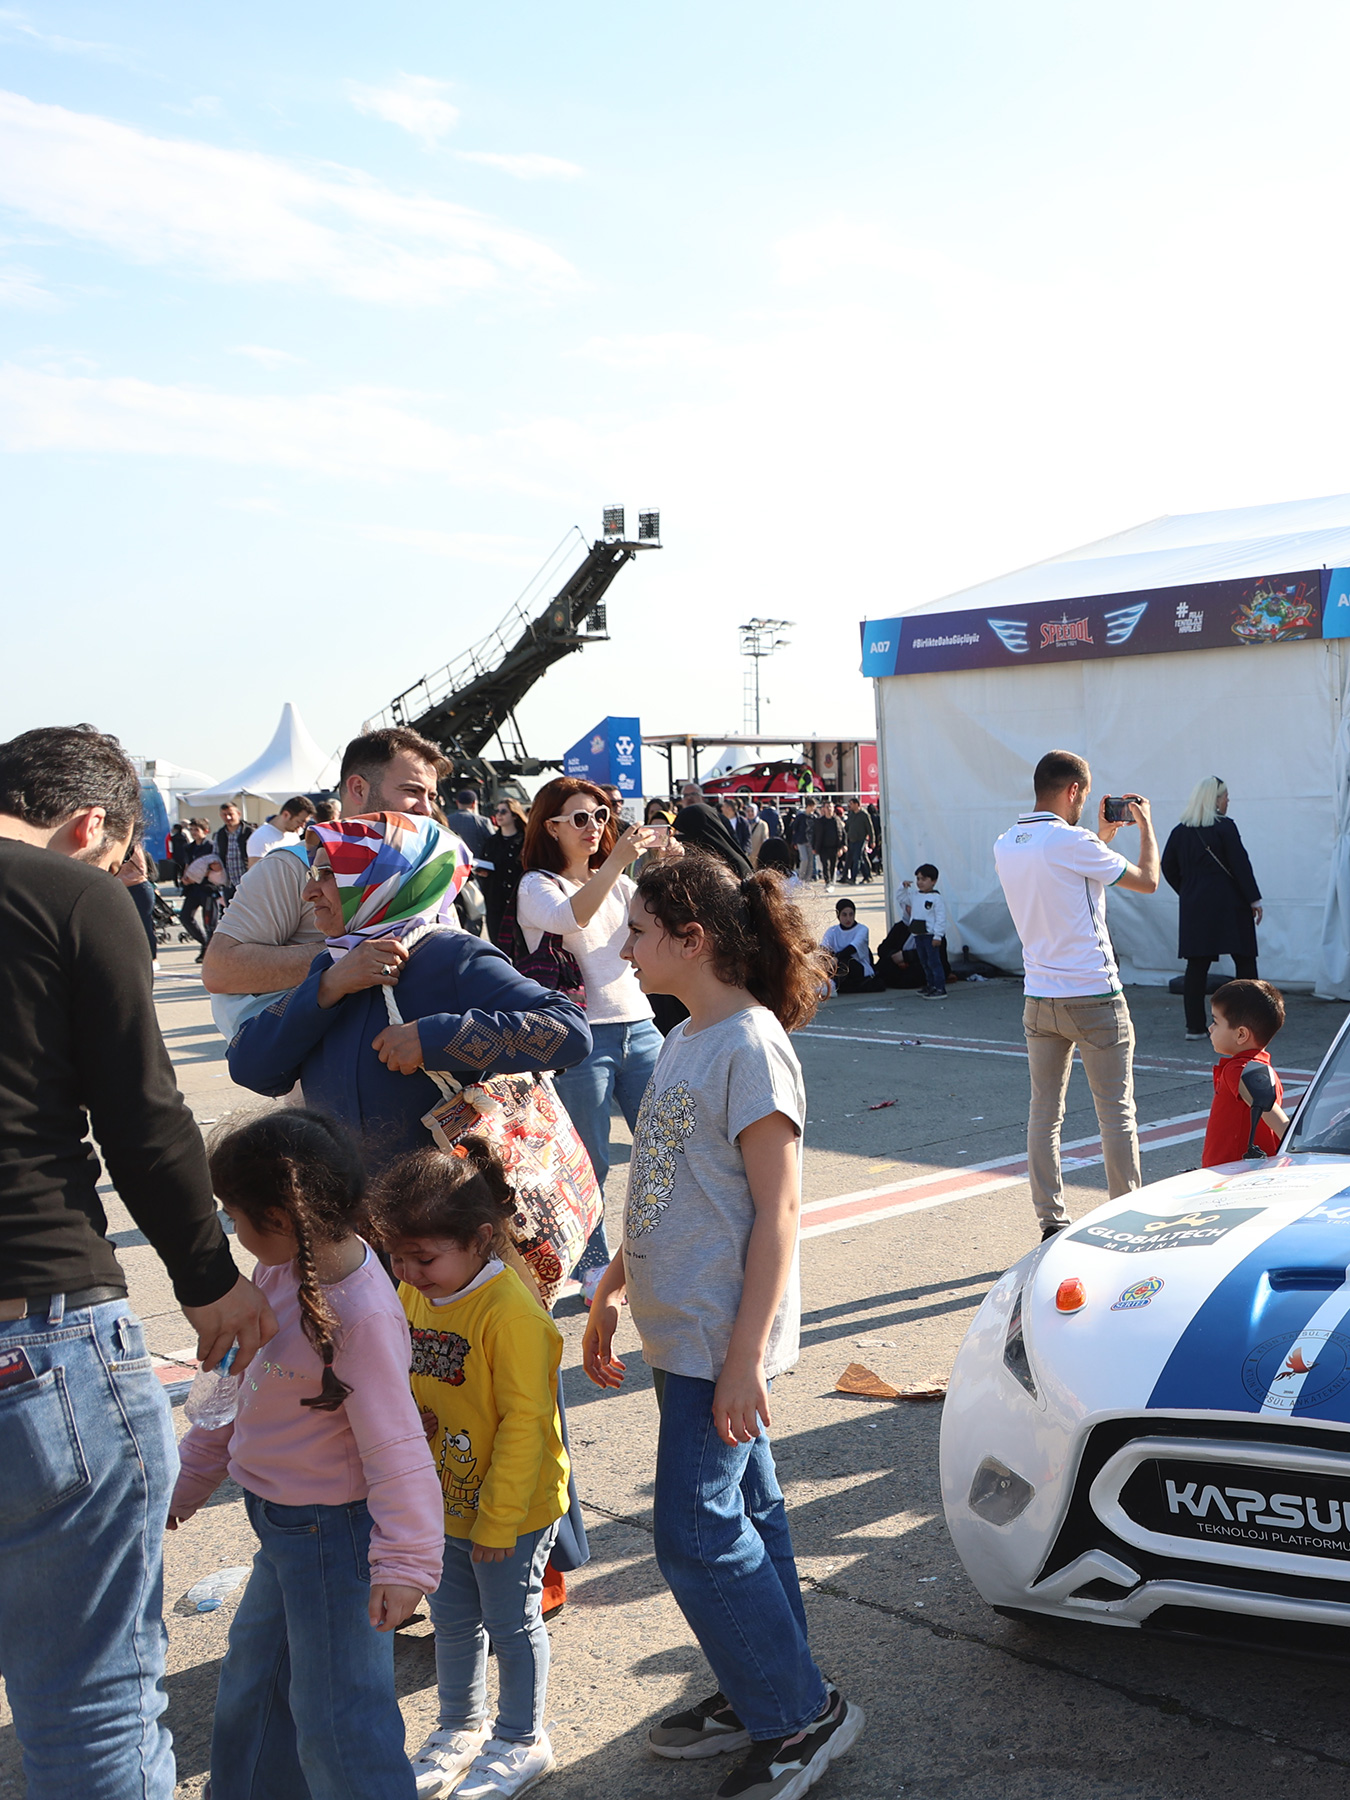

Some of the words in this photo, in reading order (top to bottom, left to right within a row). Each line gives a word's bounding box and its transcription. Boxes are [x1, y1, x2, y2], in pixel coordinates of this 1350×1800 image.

[1040, 617, 1094, 648] SPEEDOL
[870, 641, 890, 653] A07
[1087, 1226, 1229, 1245] GLOBALTECH
[1197, 1522, 1269, 1541] TEKNOLOJI
